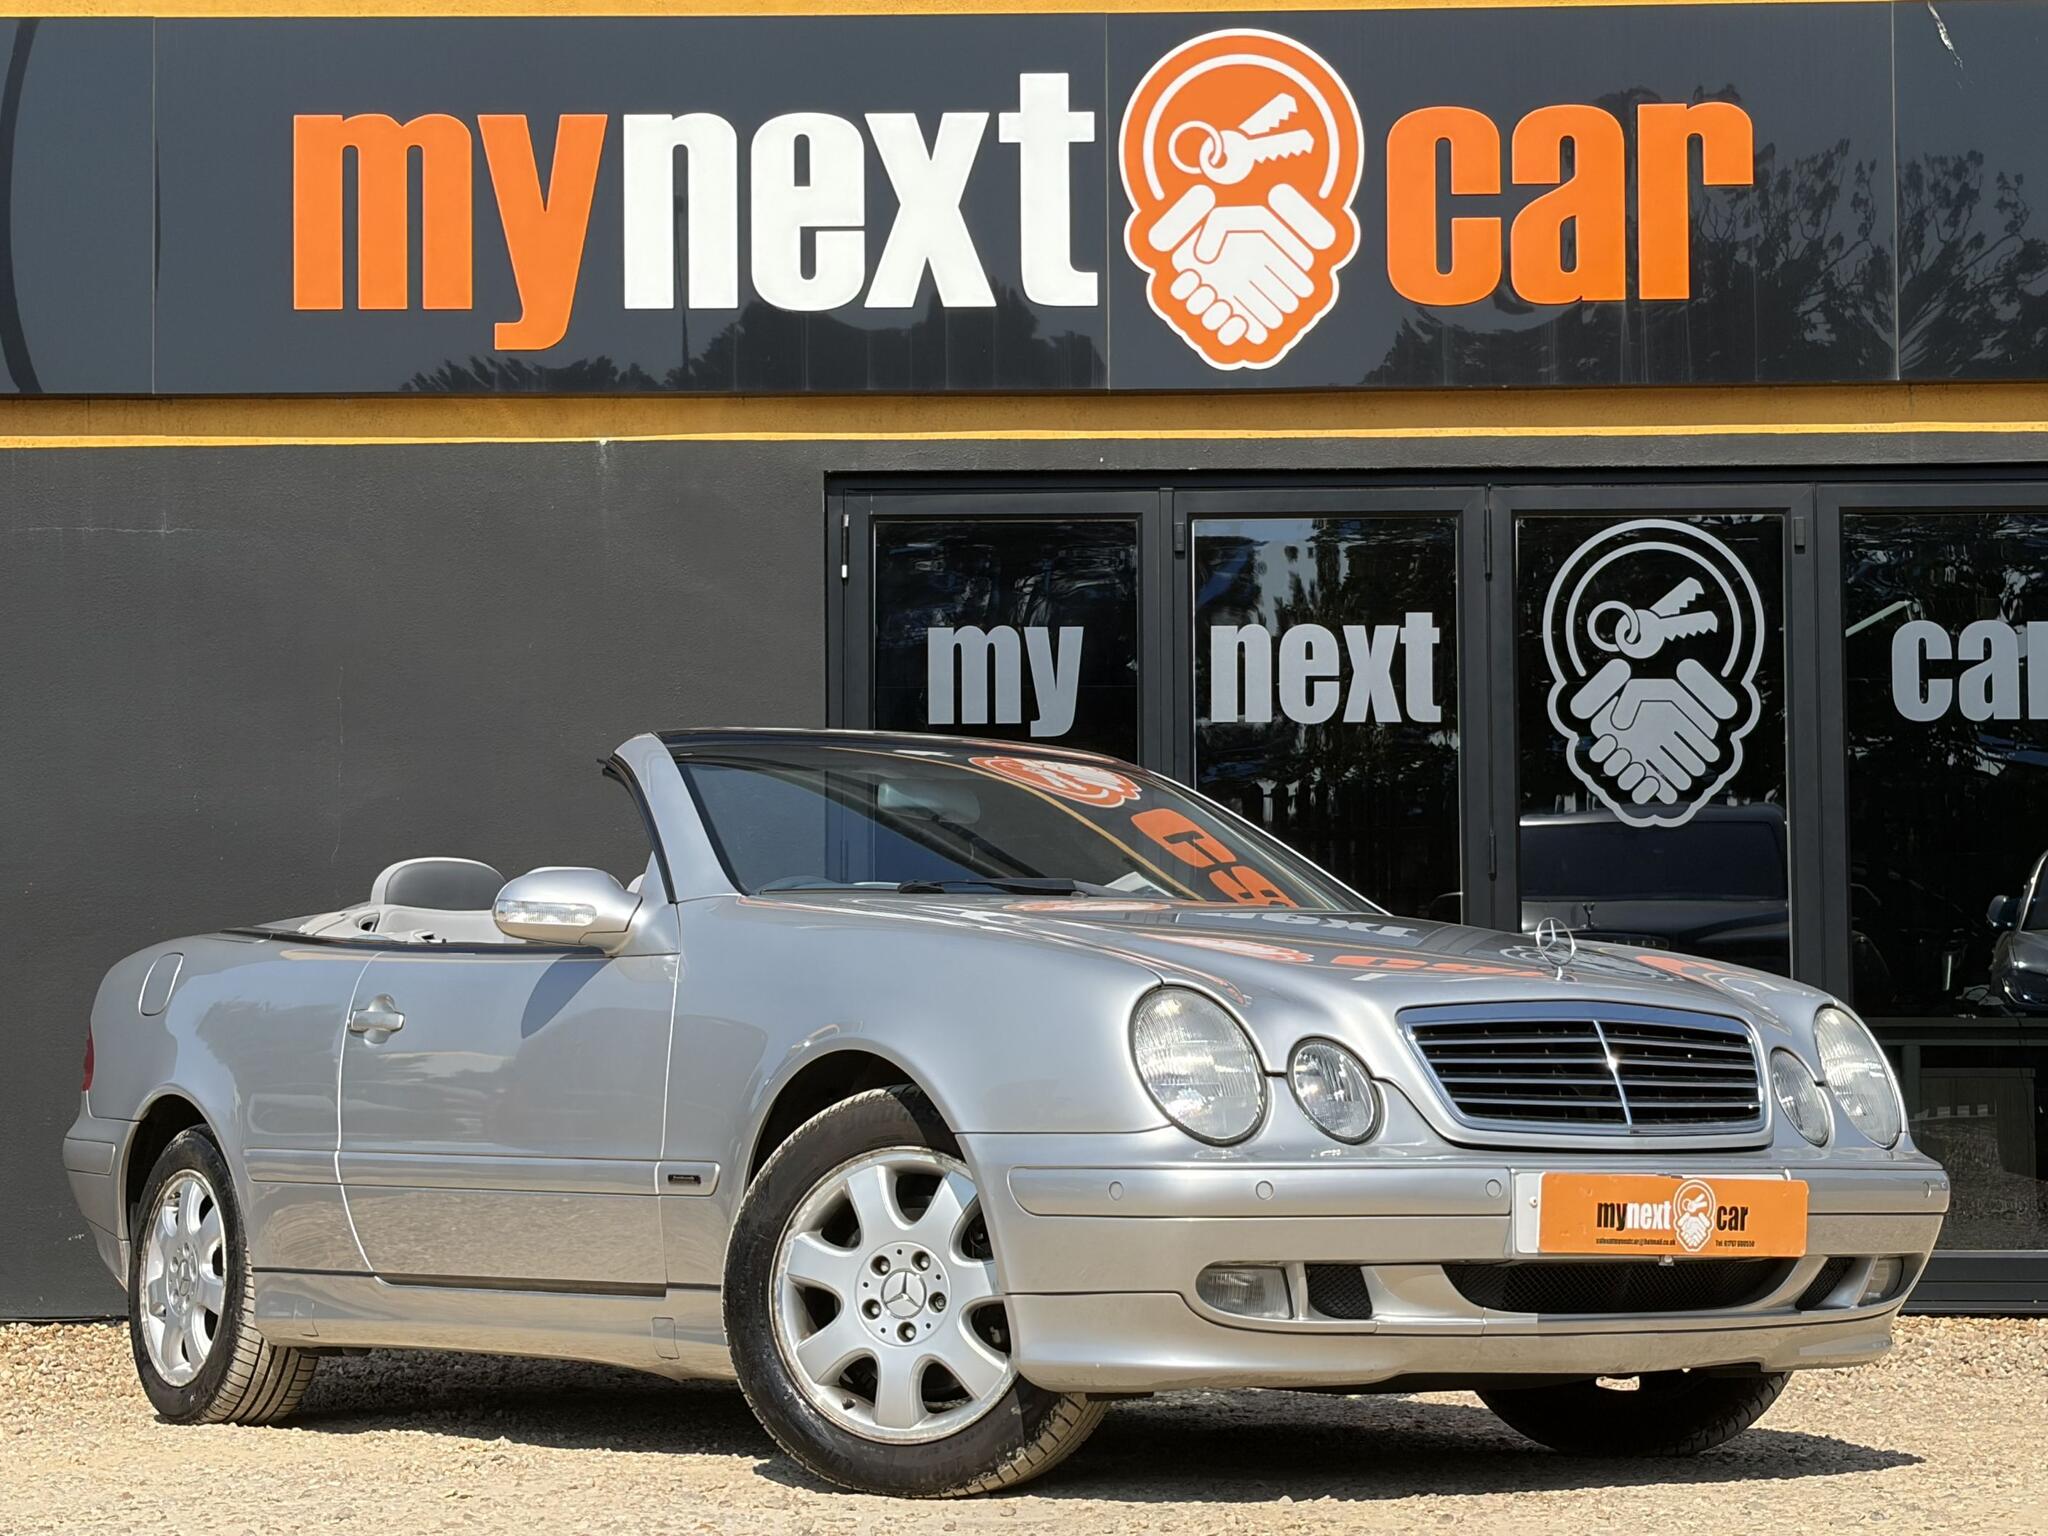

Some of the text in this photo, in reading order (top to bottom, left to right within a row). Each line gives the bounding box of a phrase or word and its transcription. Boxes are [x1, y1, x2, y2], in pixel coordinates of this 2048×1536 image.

[1386, 101, 1754, 307] car
[926, 624, 1085, 738] my
[1210, 611, 1443, 724] next
[1716, 1203, 1749, 1232] car
